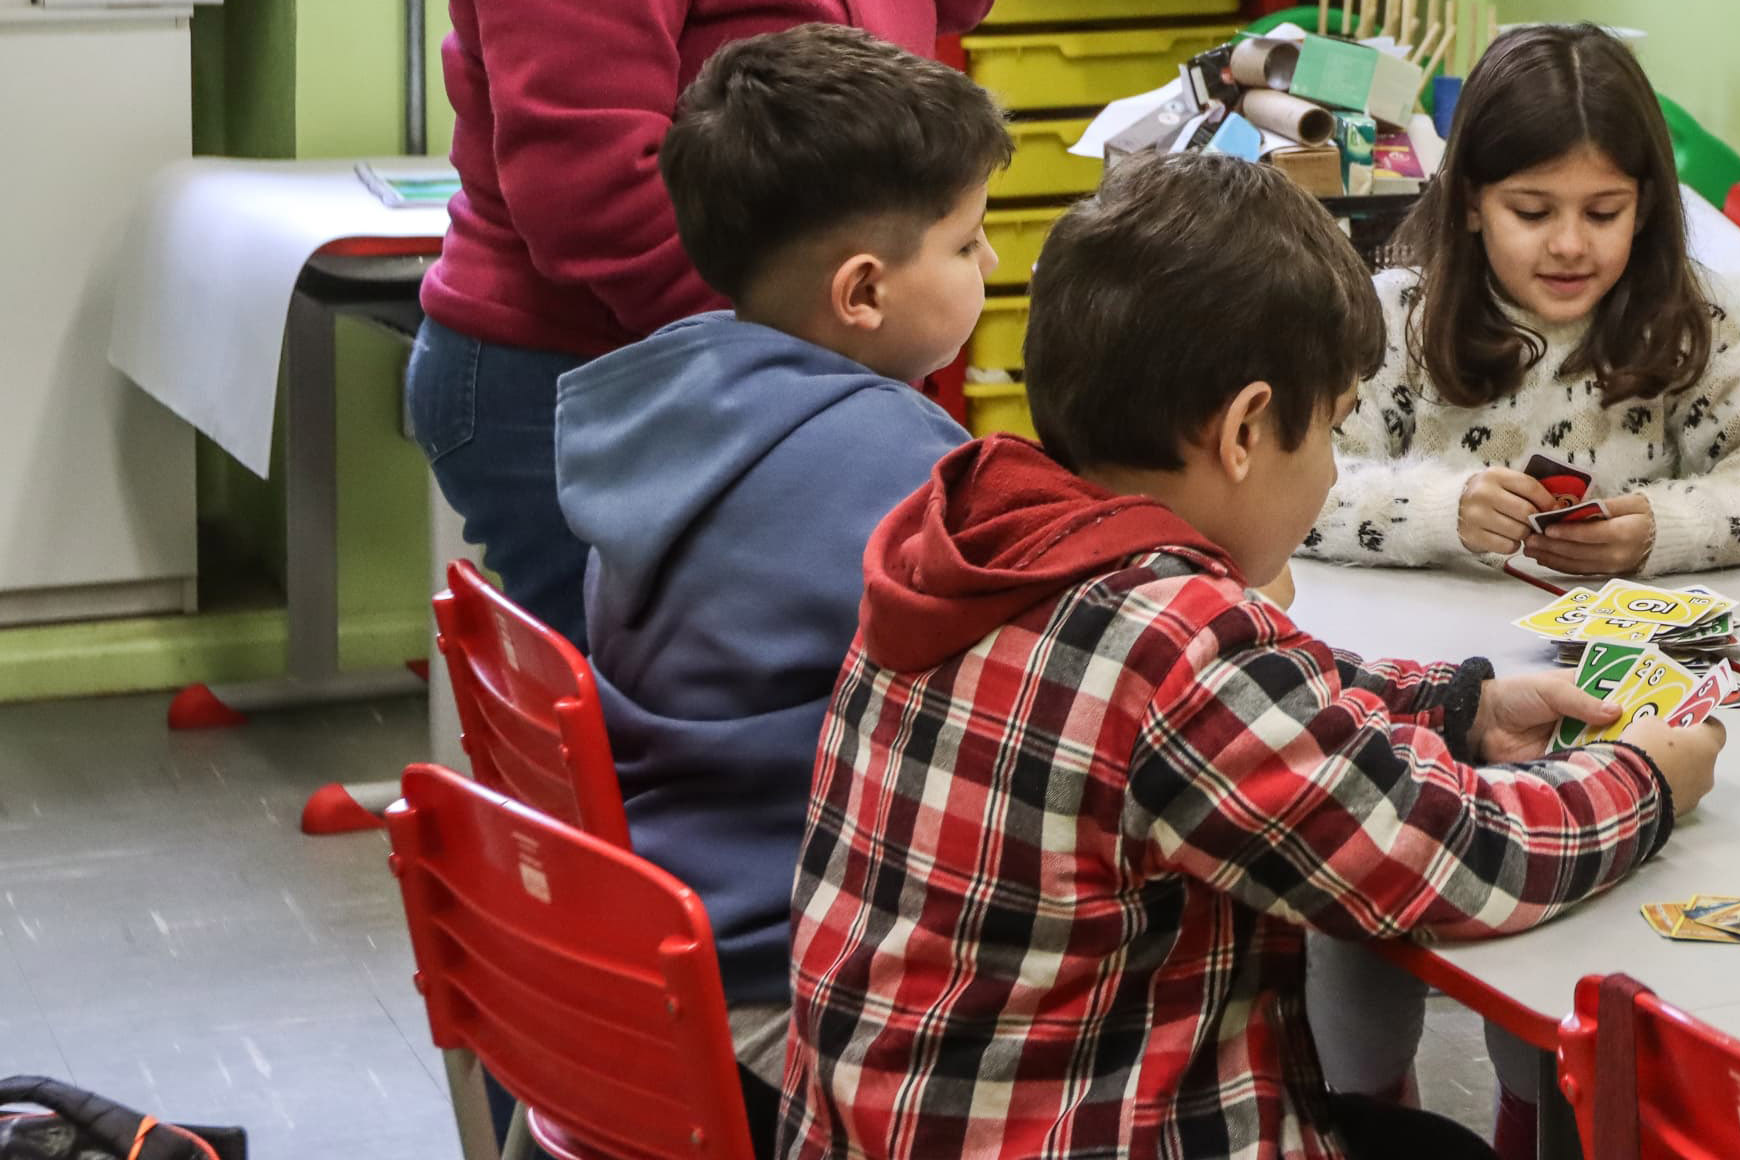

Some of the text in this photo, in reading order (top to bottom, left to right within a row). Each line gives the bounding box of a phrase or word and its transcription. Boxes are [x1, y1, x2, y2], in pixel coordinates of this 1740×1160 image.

[1591, 646, 1608, 666] 7
[1636, 659, 1654, 679] 2
[1648, 666, 1666, 686] 8
